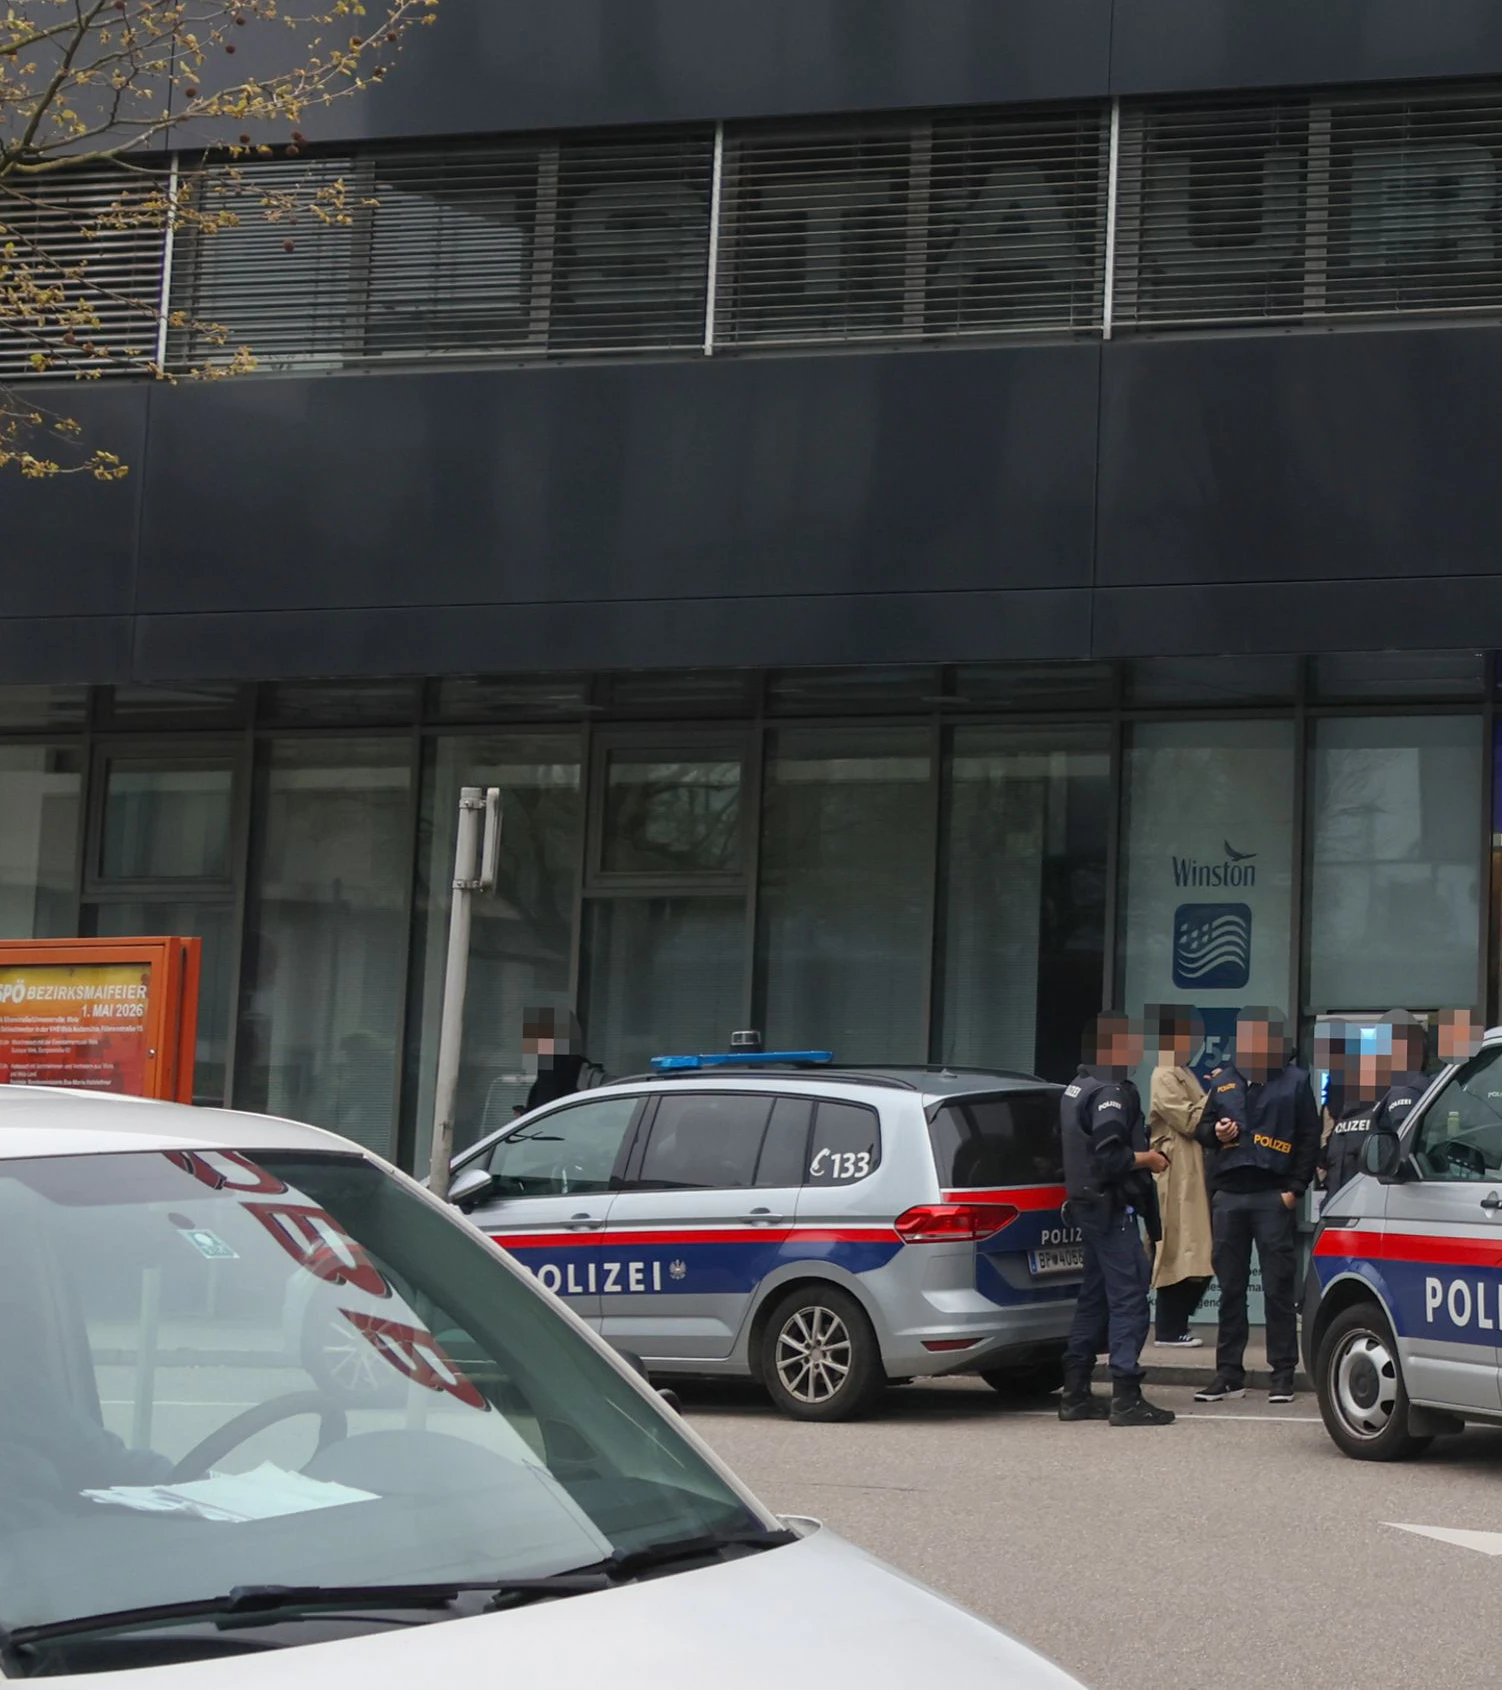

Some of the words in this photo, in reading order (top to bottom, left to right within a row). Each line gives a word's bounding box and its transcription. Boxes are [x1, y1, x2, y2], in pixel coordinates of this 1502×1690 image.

[1172, 855, 1255, 888] Winston
[26, 985, 147, 1000] BEZIRKSMAIFEIER
[82, 1005, 91, 1017] 1.
[93, 1004, 114, 1017] MAI
[116, 1004, 144, 1017] 2026
[1334, 1119, 1371, 1134] OLIZEI
[1253, 1133, 1292, 1154] POLIZEI
[831, 1151, 871, 1179] 133
[1041, 1227, 1083, 1245] POLIZ
[523, 1261, 662, 1293] OLIZEI
